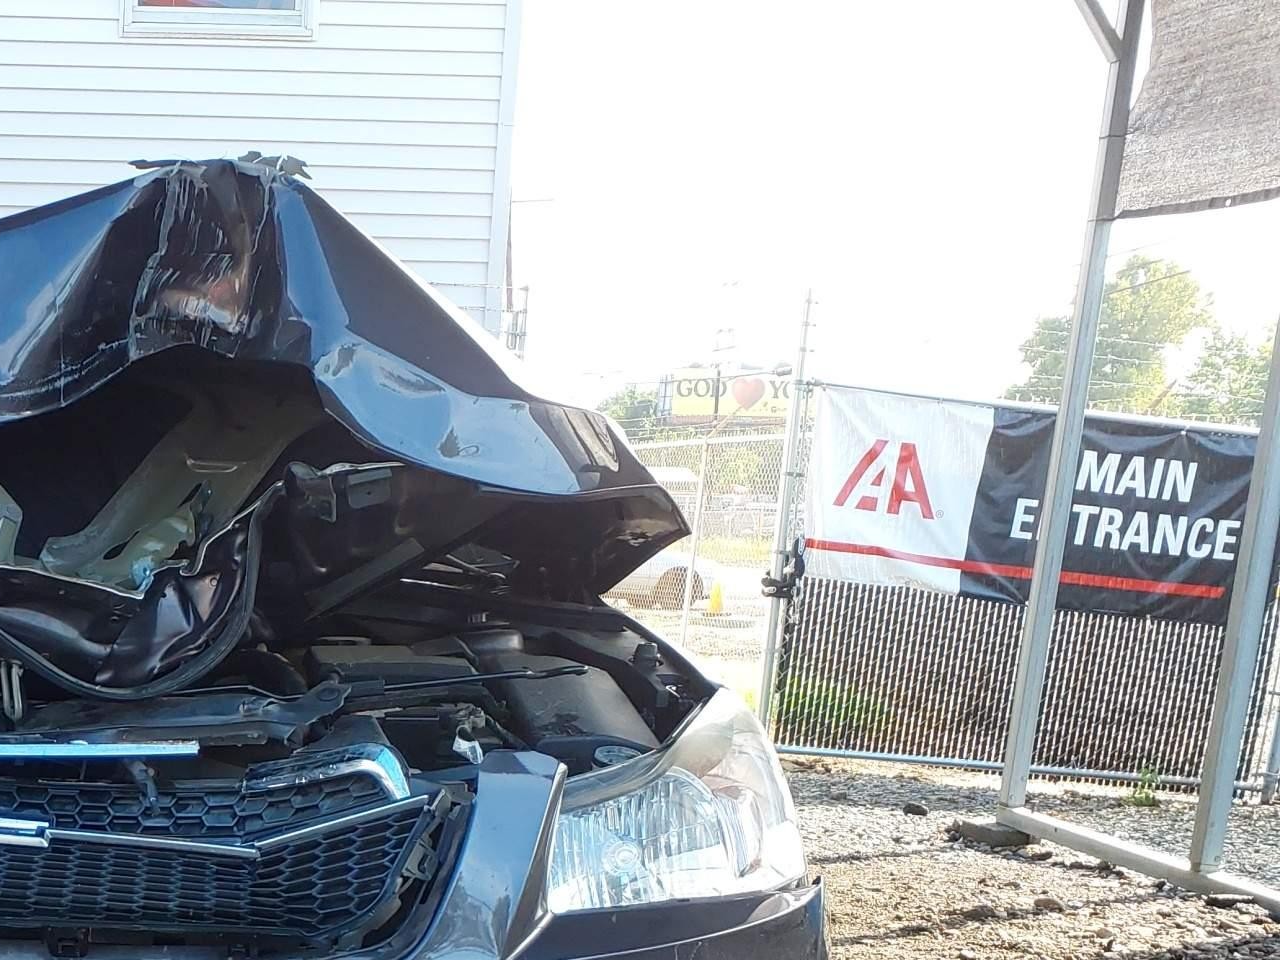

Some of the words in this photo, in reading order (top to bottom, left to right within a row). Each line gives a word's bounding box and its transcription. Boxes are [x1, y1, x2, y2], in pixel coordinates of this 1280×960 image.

[676, 378, 727, 398] GOD
[1075, 450, 1198, 503] MAIN
[1009, 498, 1241, 561] ETRANCE
